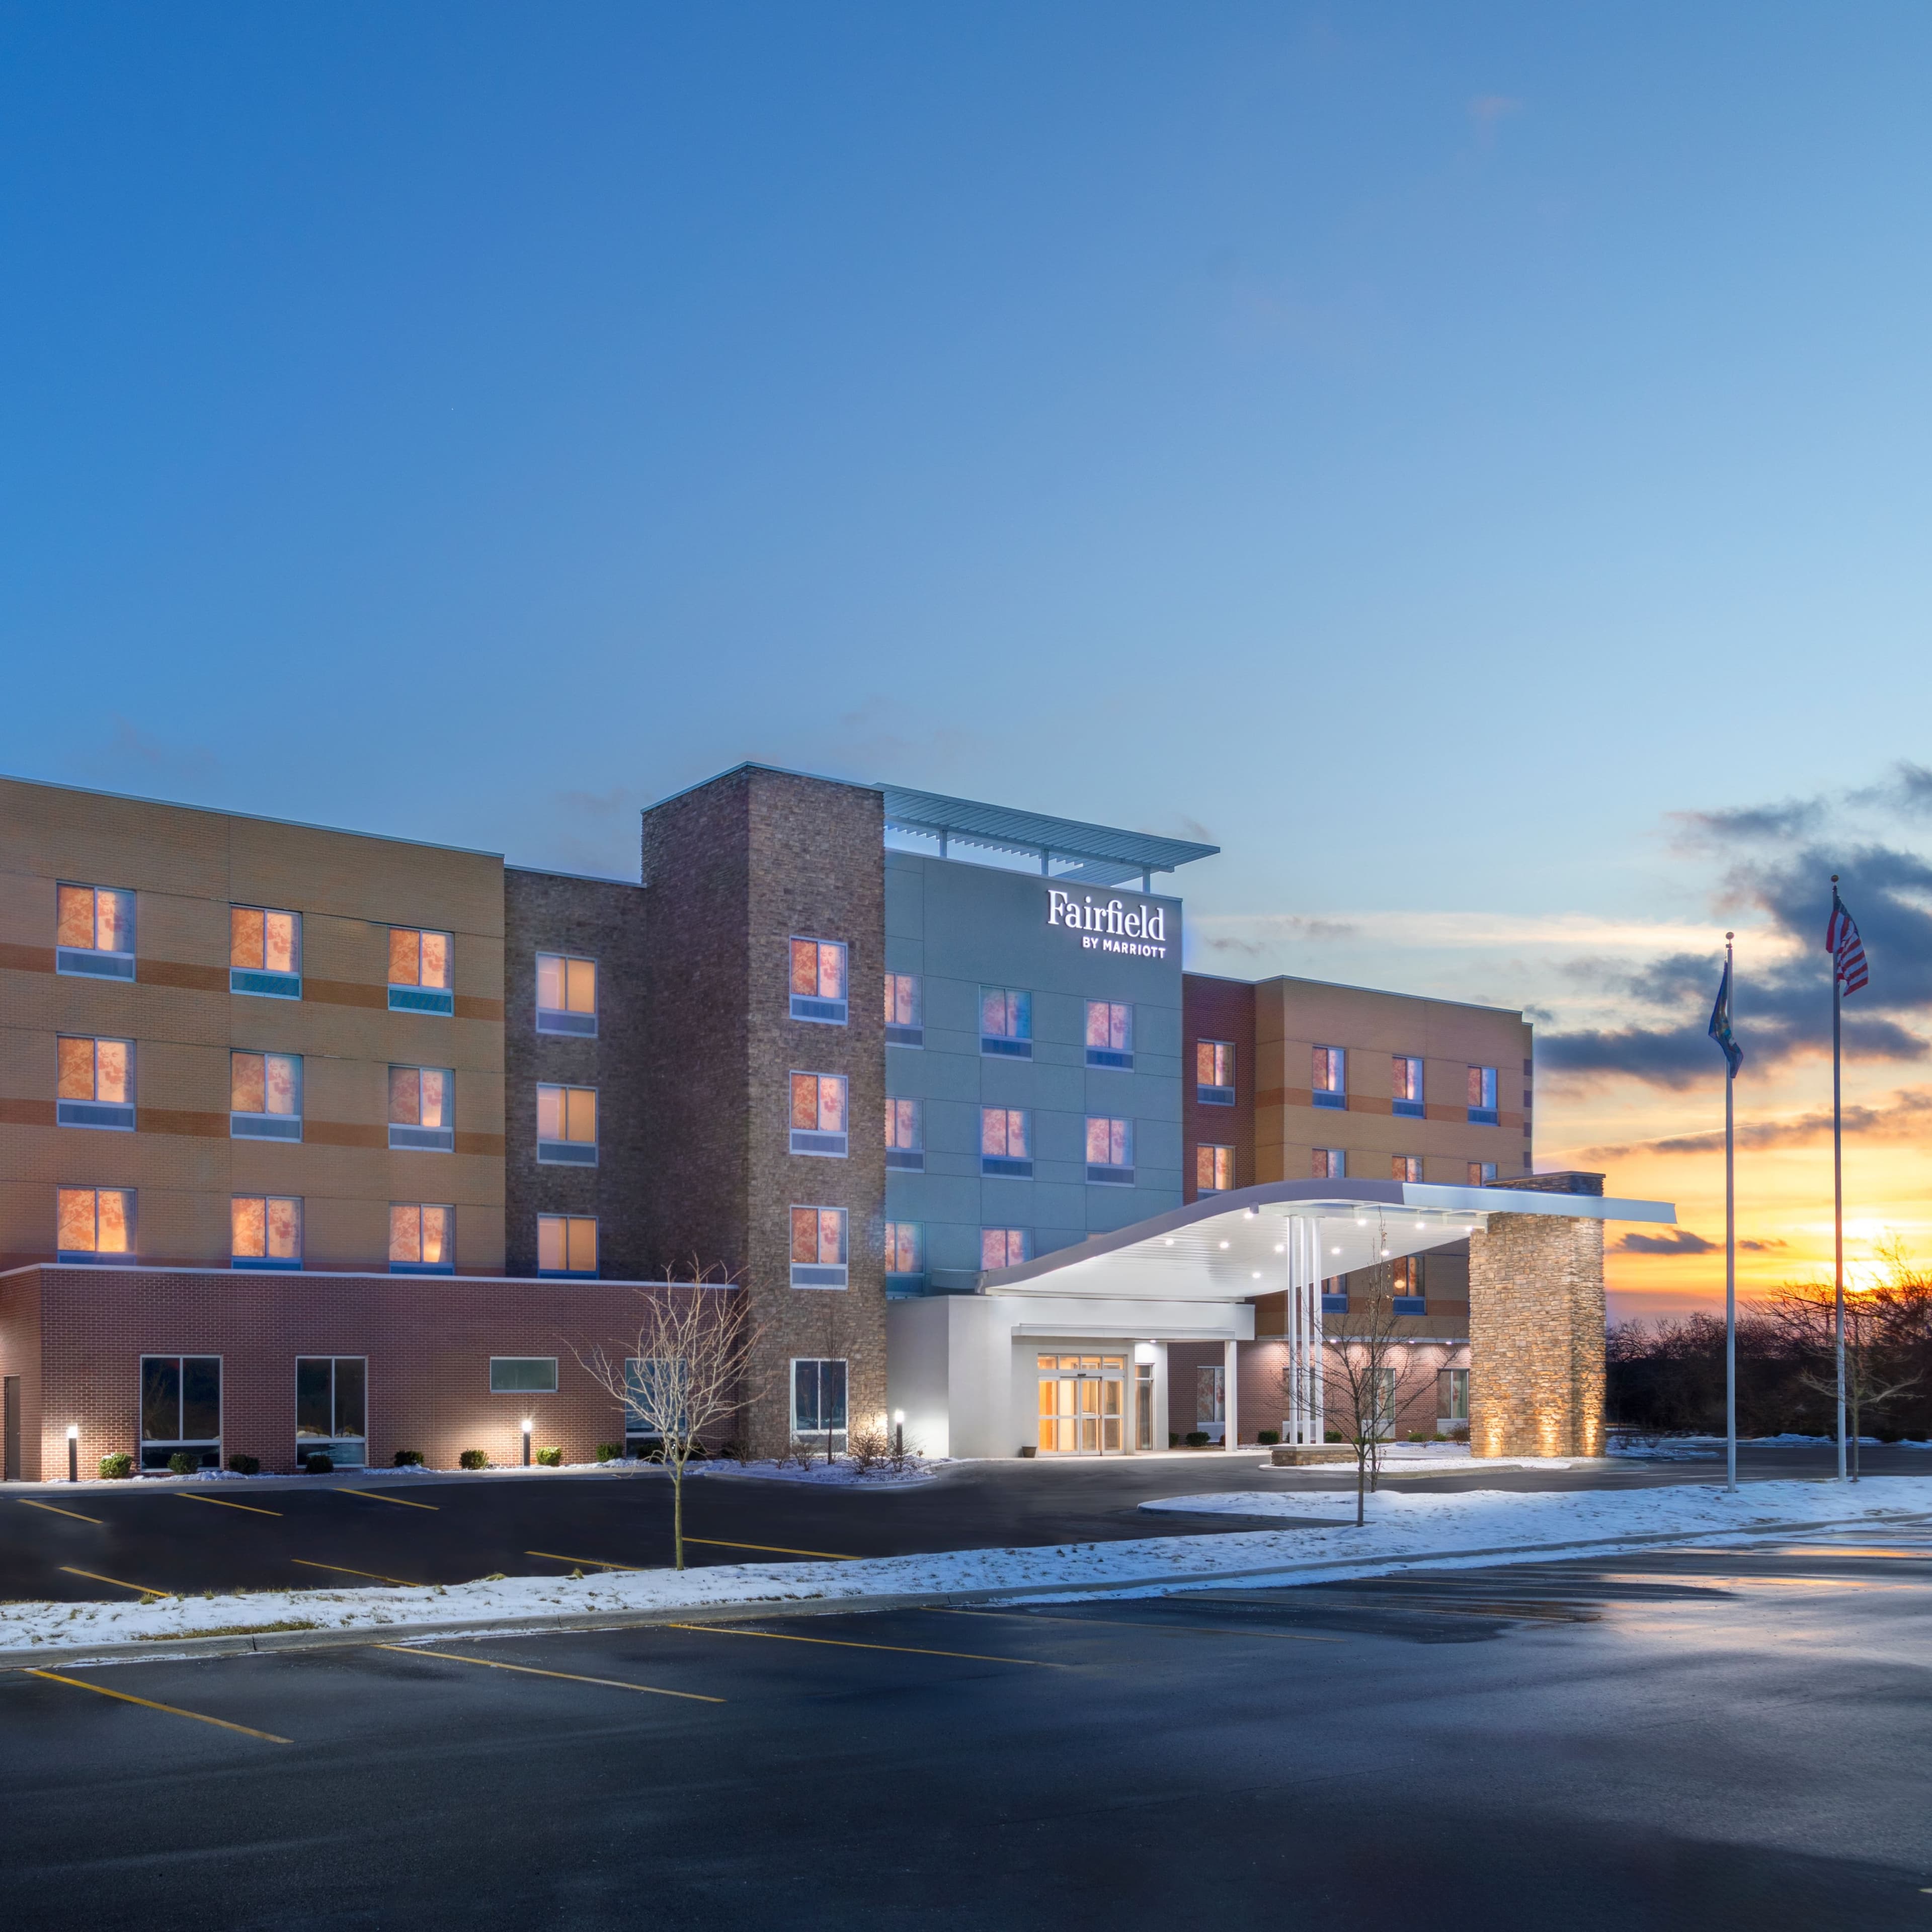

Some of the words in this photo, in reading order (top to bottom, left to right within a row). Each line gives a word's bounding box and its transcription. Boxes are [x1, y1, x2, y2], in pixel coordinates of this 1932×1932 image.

[1048, 890, 1166, 941] Fairfield
[1083, 936, 1099, 949] BY
[1103, 940, 1166, 958] MARRIOTT
